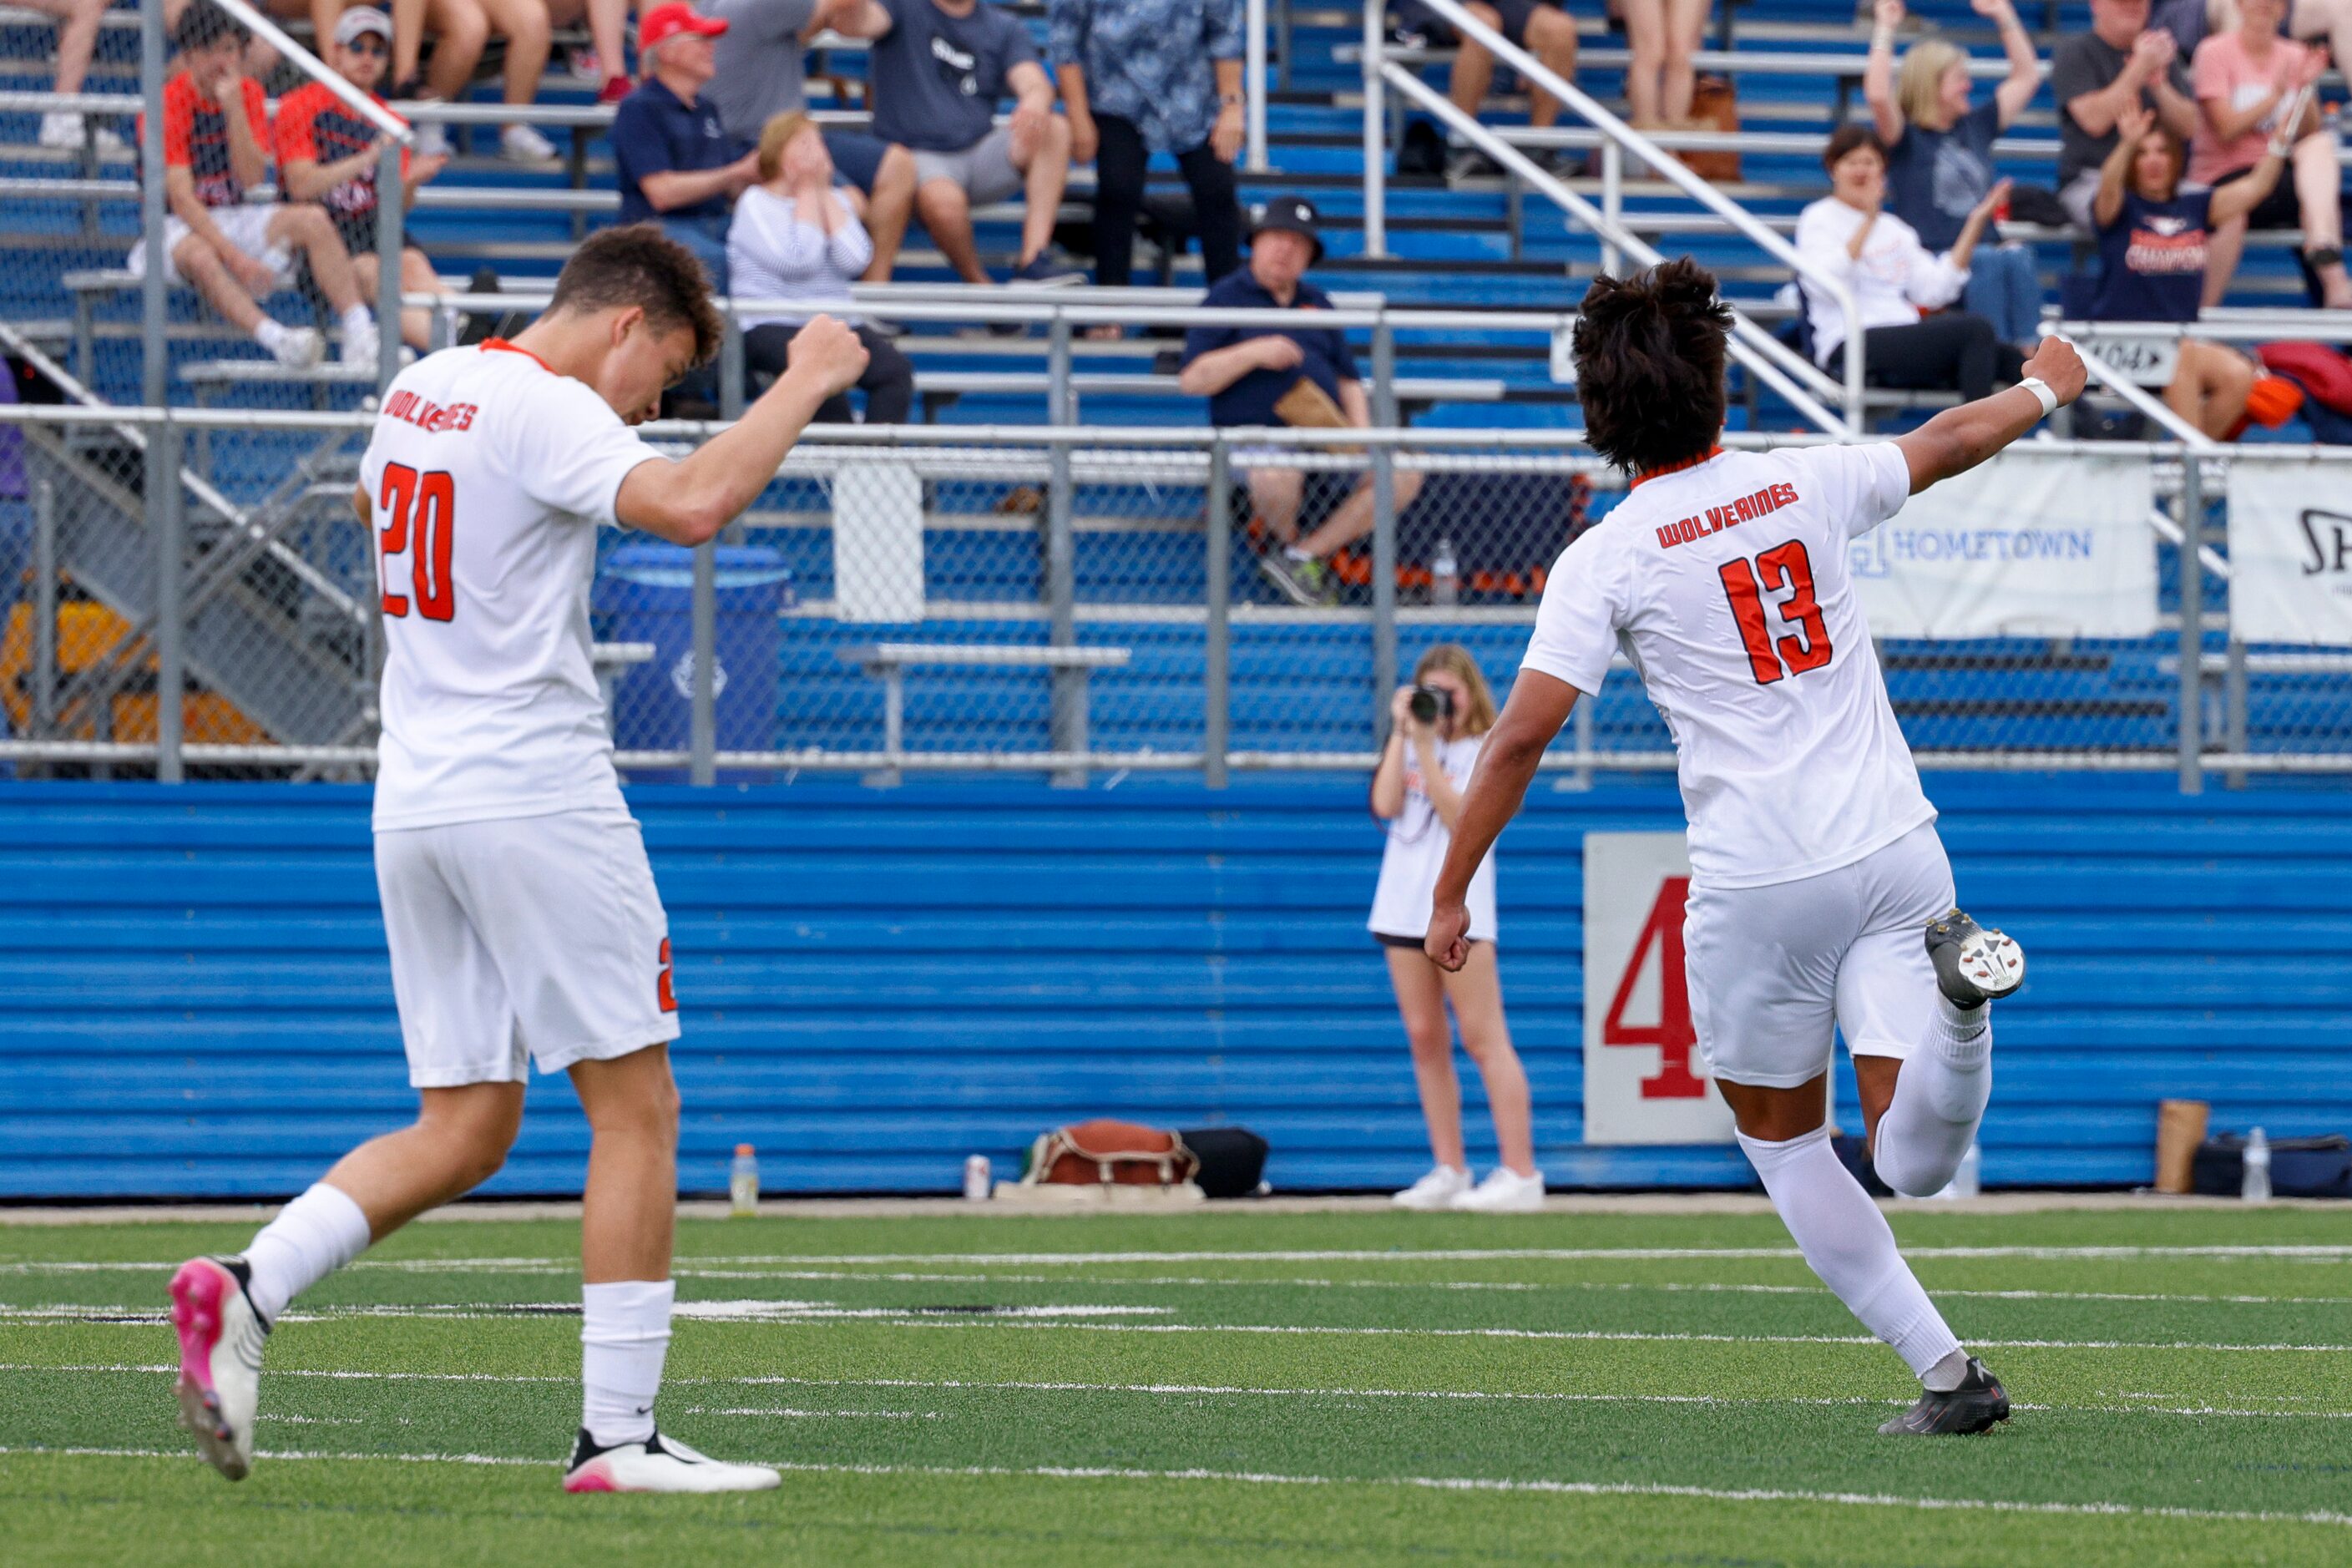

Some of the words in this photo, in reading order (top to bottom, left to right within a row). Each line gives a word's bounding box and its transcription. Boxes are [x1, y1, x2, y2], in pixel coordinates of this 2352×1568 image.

[381, 461, 454, 621] 20
[1656, 483, 1799, 549] WOLVERINES
[1892, 528, 2093, 560] HOMETOWN
[1717, 539, 1833, 685] 13
[1603, 877, 1705, 1099] 4
